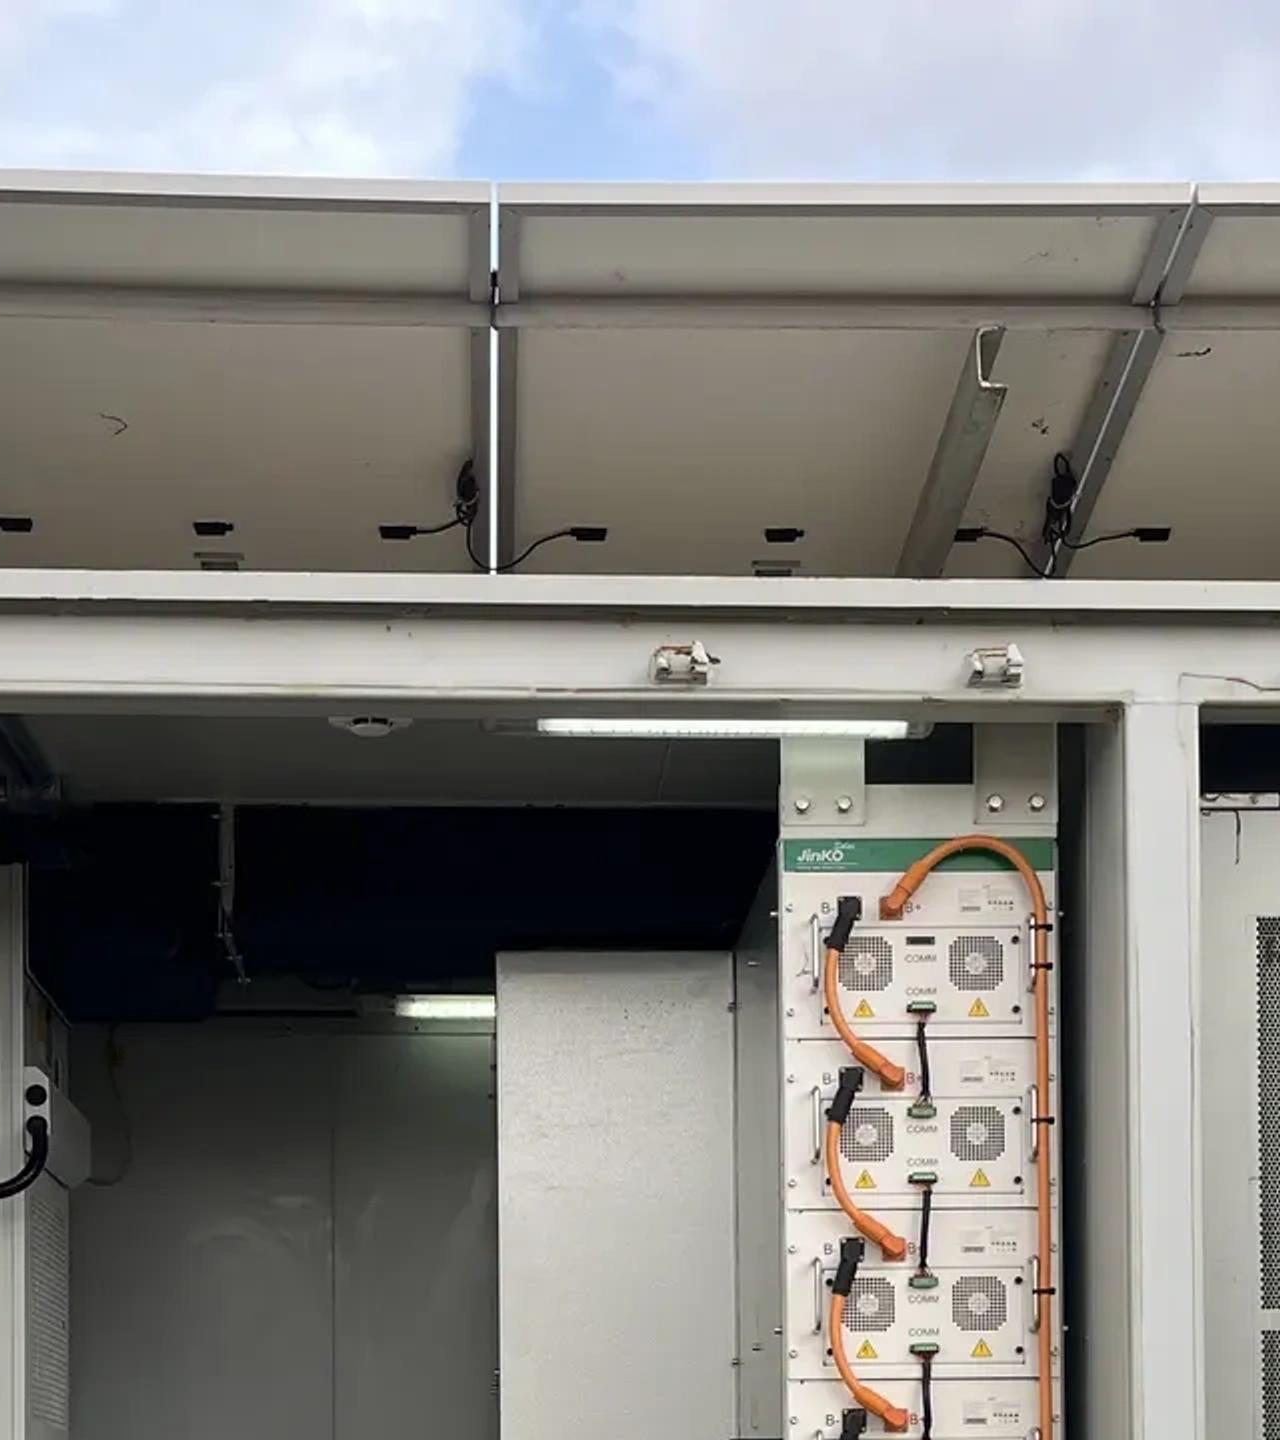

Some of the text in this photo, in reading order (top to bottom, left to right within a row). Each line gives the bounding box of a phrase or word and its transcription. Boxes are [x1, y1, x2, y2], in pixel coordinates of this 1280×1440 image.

[820, 901, 834, 914] B-
[904, 902, 921, 913] B+
[904, 954, 937, 963] COMM
[906, 986, 938, 996] COMM
[906, 1125, 939, 1134] COMM
[906, 1157, 939, 1166] COMM
[908, 1295, 940, 1304] COMM
[908, 1327, 940, 1336] COMM
[825, 1414, 839, 1427] B-
